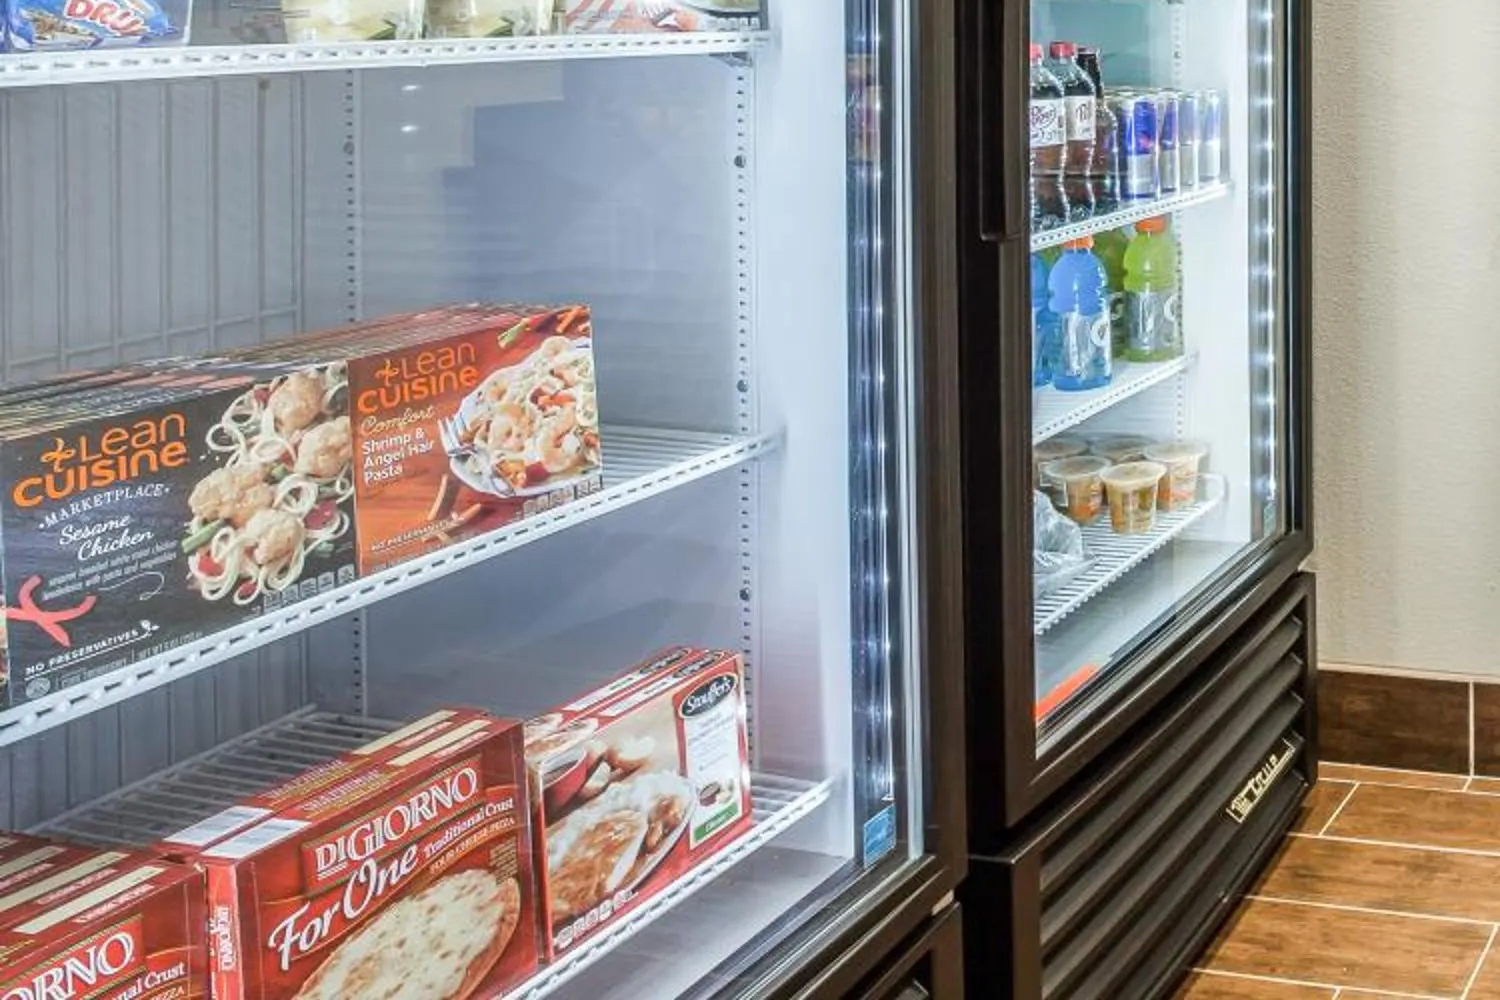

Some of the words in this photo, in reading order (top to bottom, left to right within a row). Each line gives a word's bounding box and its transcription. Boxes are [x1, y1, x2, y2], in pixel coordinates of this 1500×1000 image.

[402, 341, 476, 374] Lean
[360, 404, 435, 437] Comfort
[80, 412, 187, 464] Lean
[362, 432, 412, 456] Shrimp
[415, 427, 425, 440] &
[363, 448, 405, 470] Angel
[408, 438, 435, 457] Hair
[363, 464, 403, 485] Pasta
[44, 482, 166, 528] MARKETPLACE
[59, 513, 131, 545] Sesame
[76, 529, 155, 561] Chicken
[25, 662, 46, 677] NO
[49, 629, 139, 668] PRESERVATIVES
[315, 767, 478, 873] DIGIORNO
[423, 809, 485, 857] Traditional
[483, 797, 514, 822] Crust
[268, 902, 341, 972] For
[343, 843, 419, 921] One
[143, 960, 187, 989] Crust
